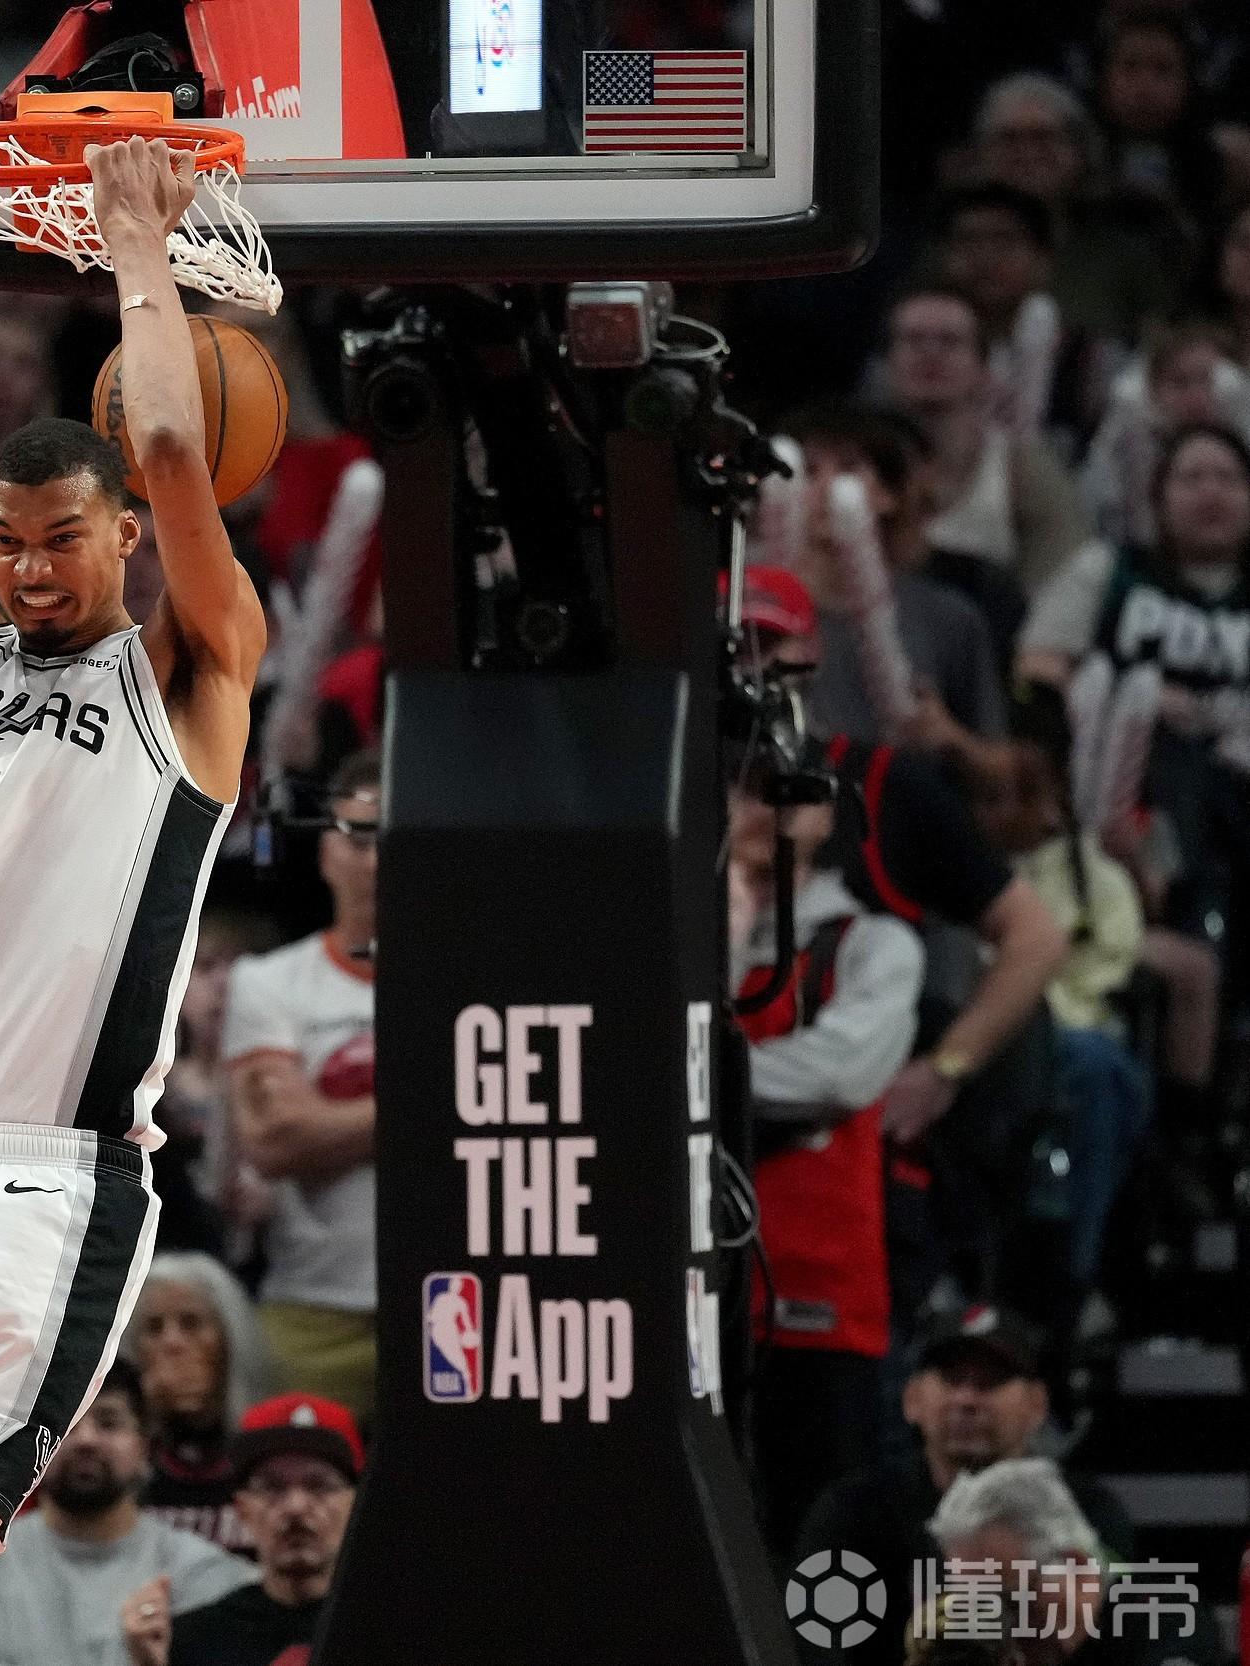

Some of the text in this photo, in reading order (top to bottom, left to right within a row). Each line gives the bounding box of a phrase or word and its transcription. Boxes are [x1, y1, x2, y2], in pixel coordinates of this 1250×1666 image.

[454, 1003, 593, 1126] GET
[453, 1137, 598, 1257] THE
[490, 1273, 633, 1423] App
